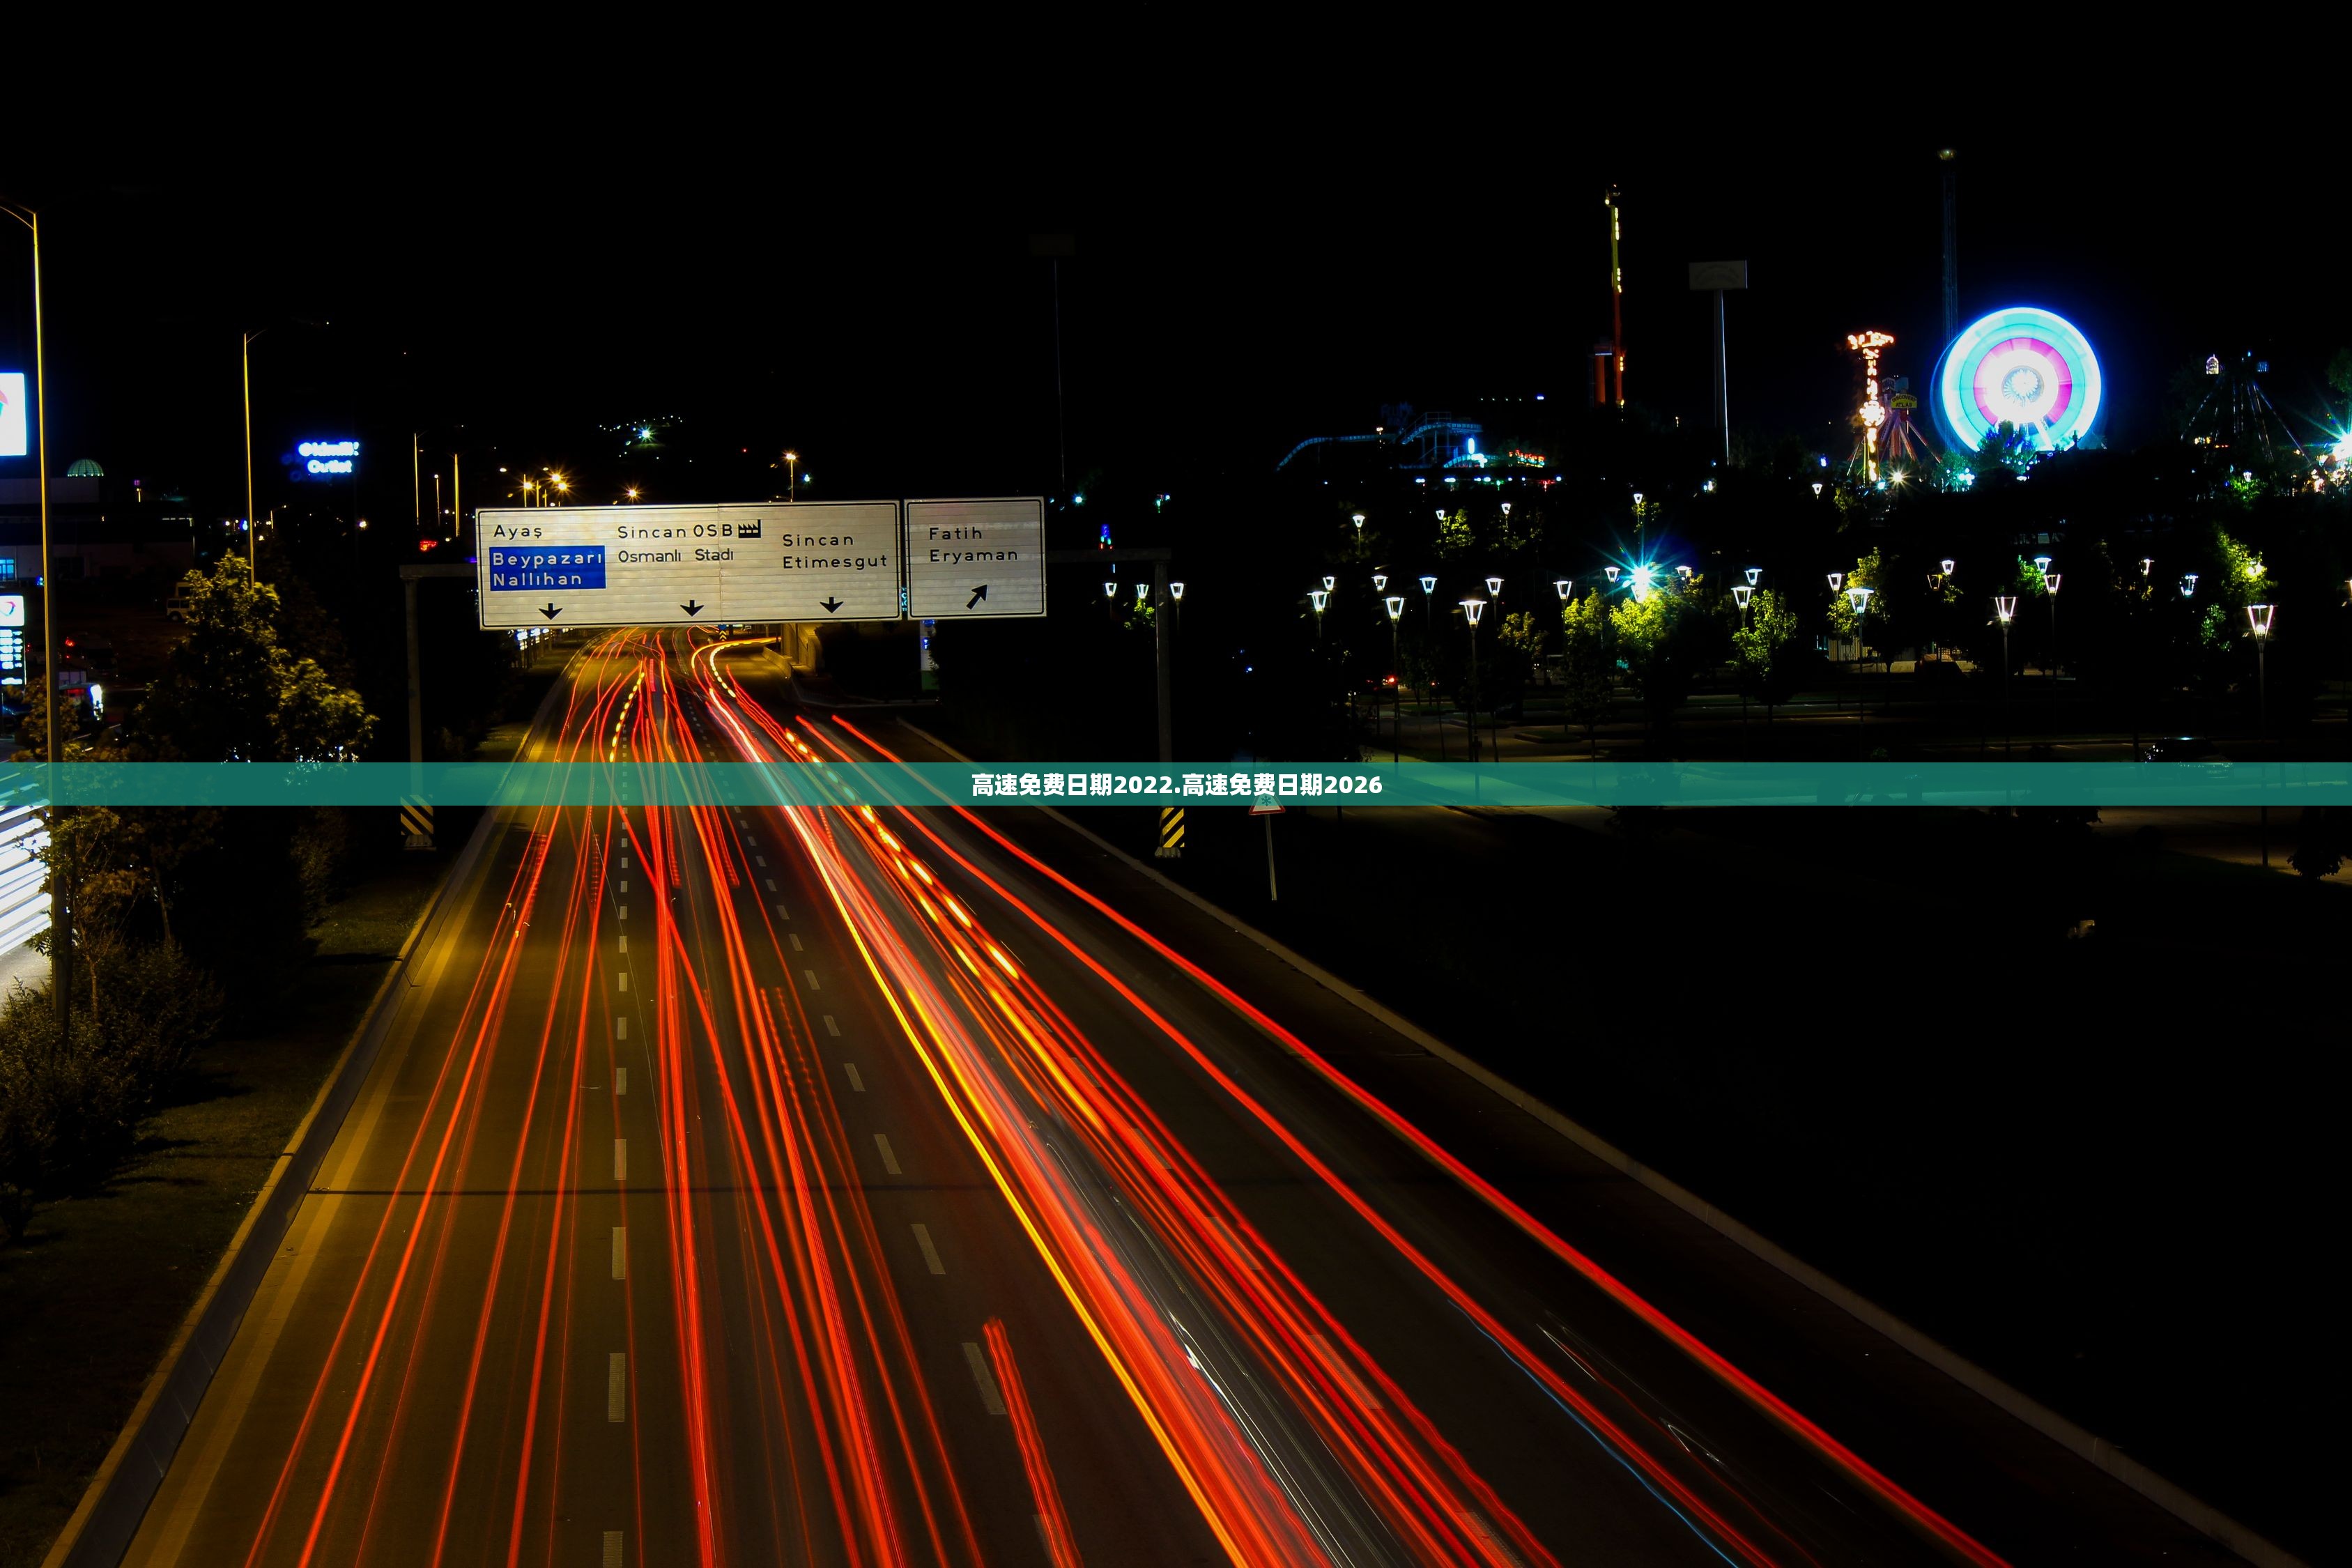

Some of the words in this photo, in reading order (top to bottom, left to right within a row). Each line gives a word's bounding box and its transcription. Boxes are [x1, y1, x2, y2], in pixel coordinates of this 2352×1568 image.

[493, 524, 542, 539] Ayaş
[617, 526, 686, 539] Sincan
[693, 523, 733, 537] OSB
[929, 527, 983, 540] Fatih
[783, 534, 854, 547] Sincan
[493, 552, 601, 569] Beypazarı
[618, 549, 682, 563] Osmanlı
[695, 548, 734, 561] Stadı
[783, 555, 887, 570] Etimesgut
[930, 548, 1018, 564] Eryaman
[493, 572, 582, 587] Nallıhan
